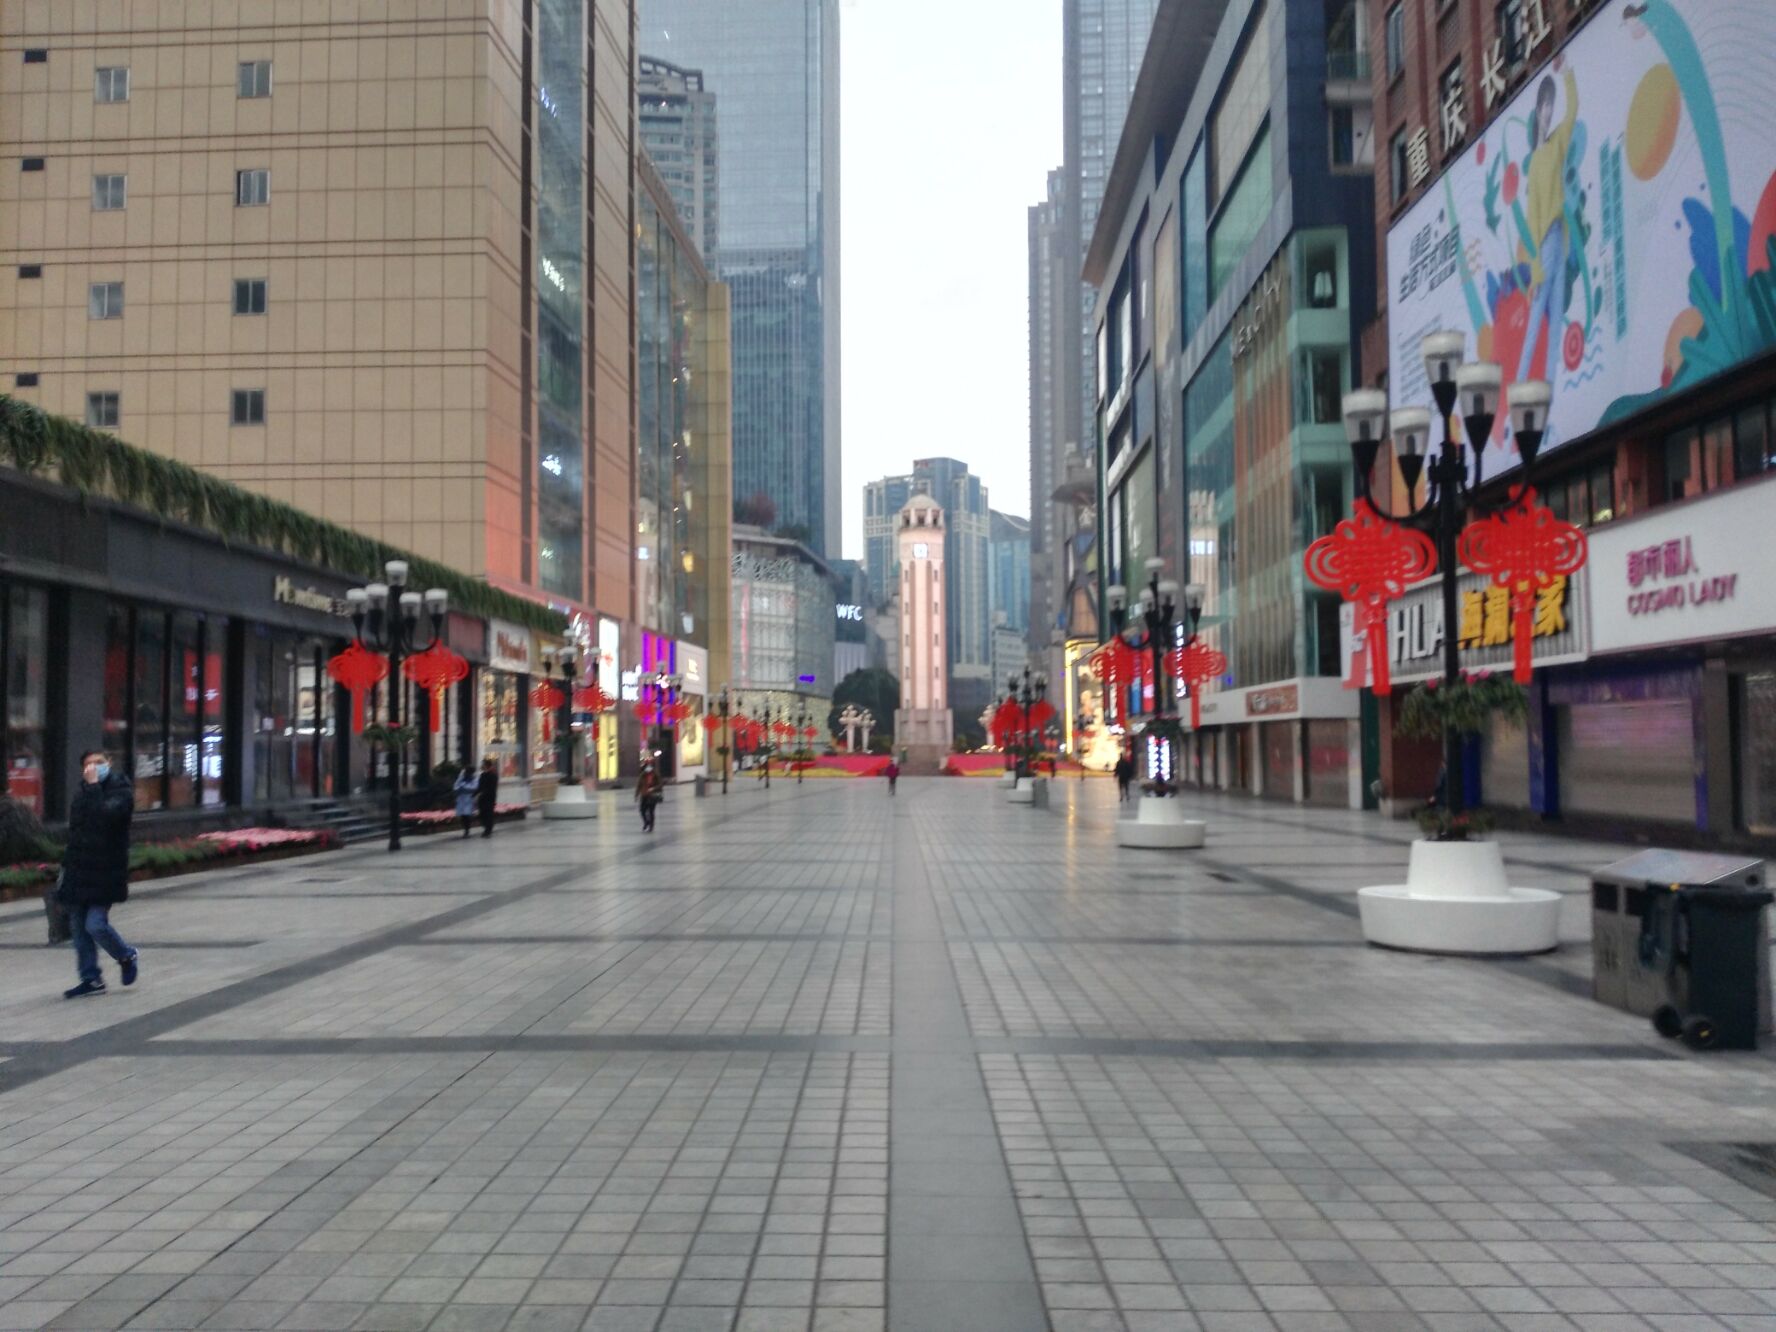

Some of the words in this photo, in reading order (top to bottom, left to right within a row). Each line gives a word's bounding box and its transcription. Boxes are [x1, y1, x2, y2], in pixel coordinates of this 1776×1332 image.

[1407, 0, 1581, 188] 重庆长江
[1626, 535, 1699, 588] 都市丽人
[835, 603, 863, 621] WFC
[1458, 574, 1567, 650] 海澜家
[1627, 584, 1685, 616] COSMO
[1689, 573, 1737, 607] LADY
